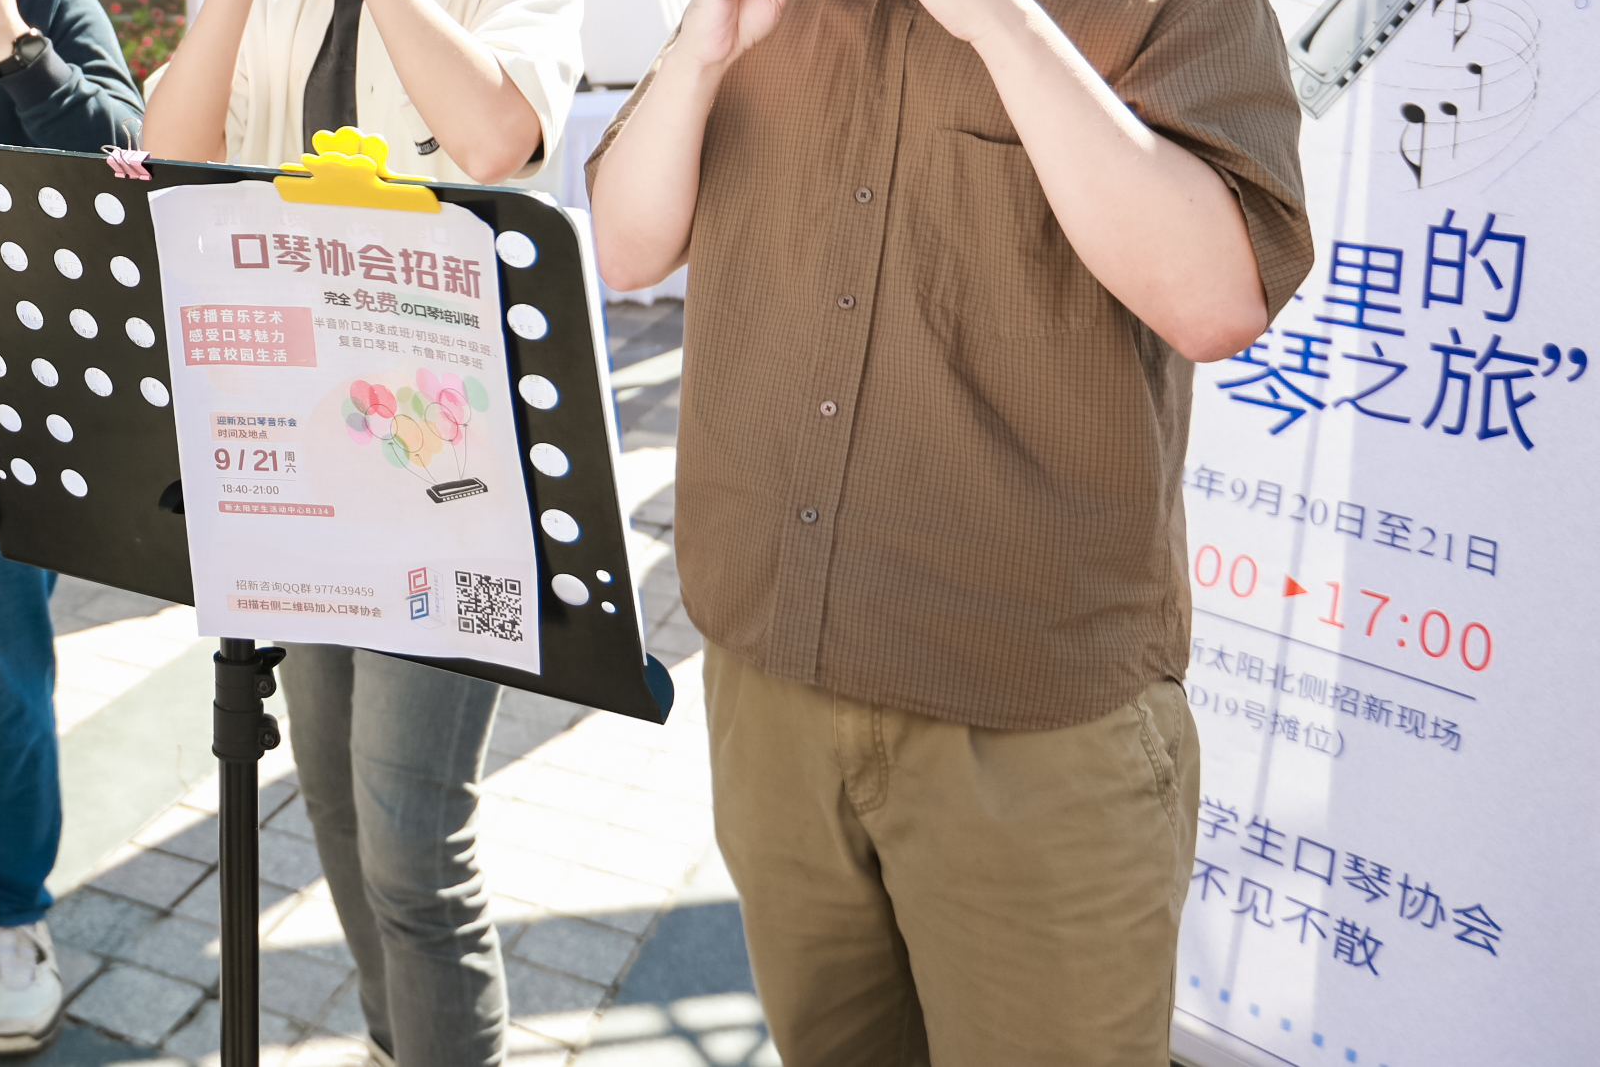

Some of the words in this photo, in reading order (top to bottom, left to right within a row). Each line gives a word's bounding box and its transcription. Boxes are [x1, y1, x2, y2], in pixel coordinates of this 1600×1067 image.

[231, 233, 482, 300] 口琴协会招新
[1293, 208, 1526, 337] 里的
[186, 309, 284, 325] 传播音乐艺术
[324, 288, 481, 330] 完全免费の口琴培训班
[189, 328, 285, 344] 感受口琴魅力
[190, 347, 288, 363] 丰富校园生活
[216, 416, 298, 427] 迎新及口琴音乐会
[217, 429, 269, 440] 时间及地点
[284, 451, 297, 473] 周六
[222, 483, 280, 495] 18:40-21:00
[1182, 464, 1498, 576] 年9月20日至21日
[235, 579, 311, 594] 招新咨询QQ群
[314, 584, 374, 597] 977439459
[237, 598, 383, 619] 扫描右侧二维码加入口琴协会
[1317, 580, 1493, 672] 17:00
[1198, 795, 1503, 958] 学生口琴协会
[1191, 856, 1384, 977] 不见不散
